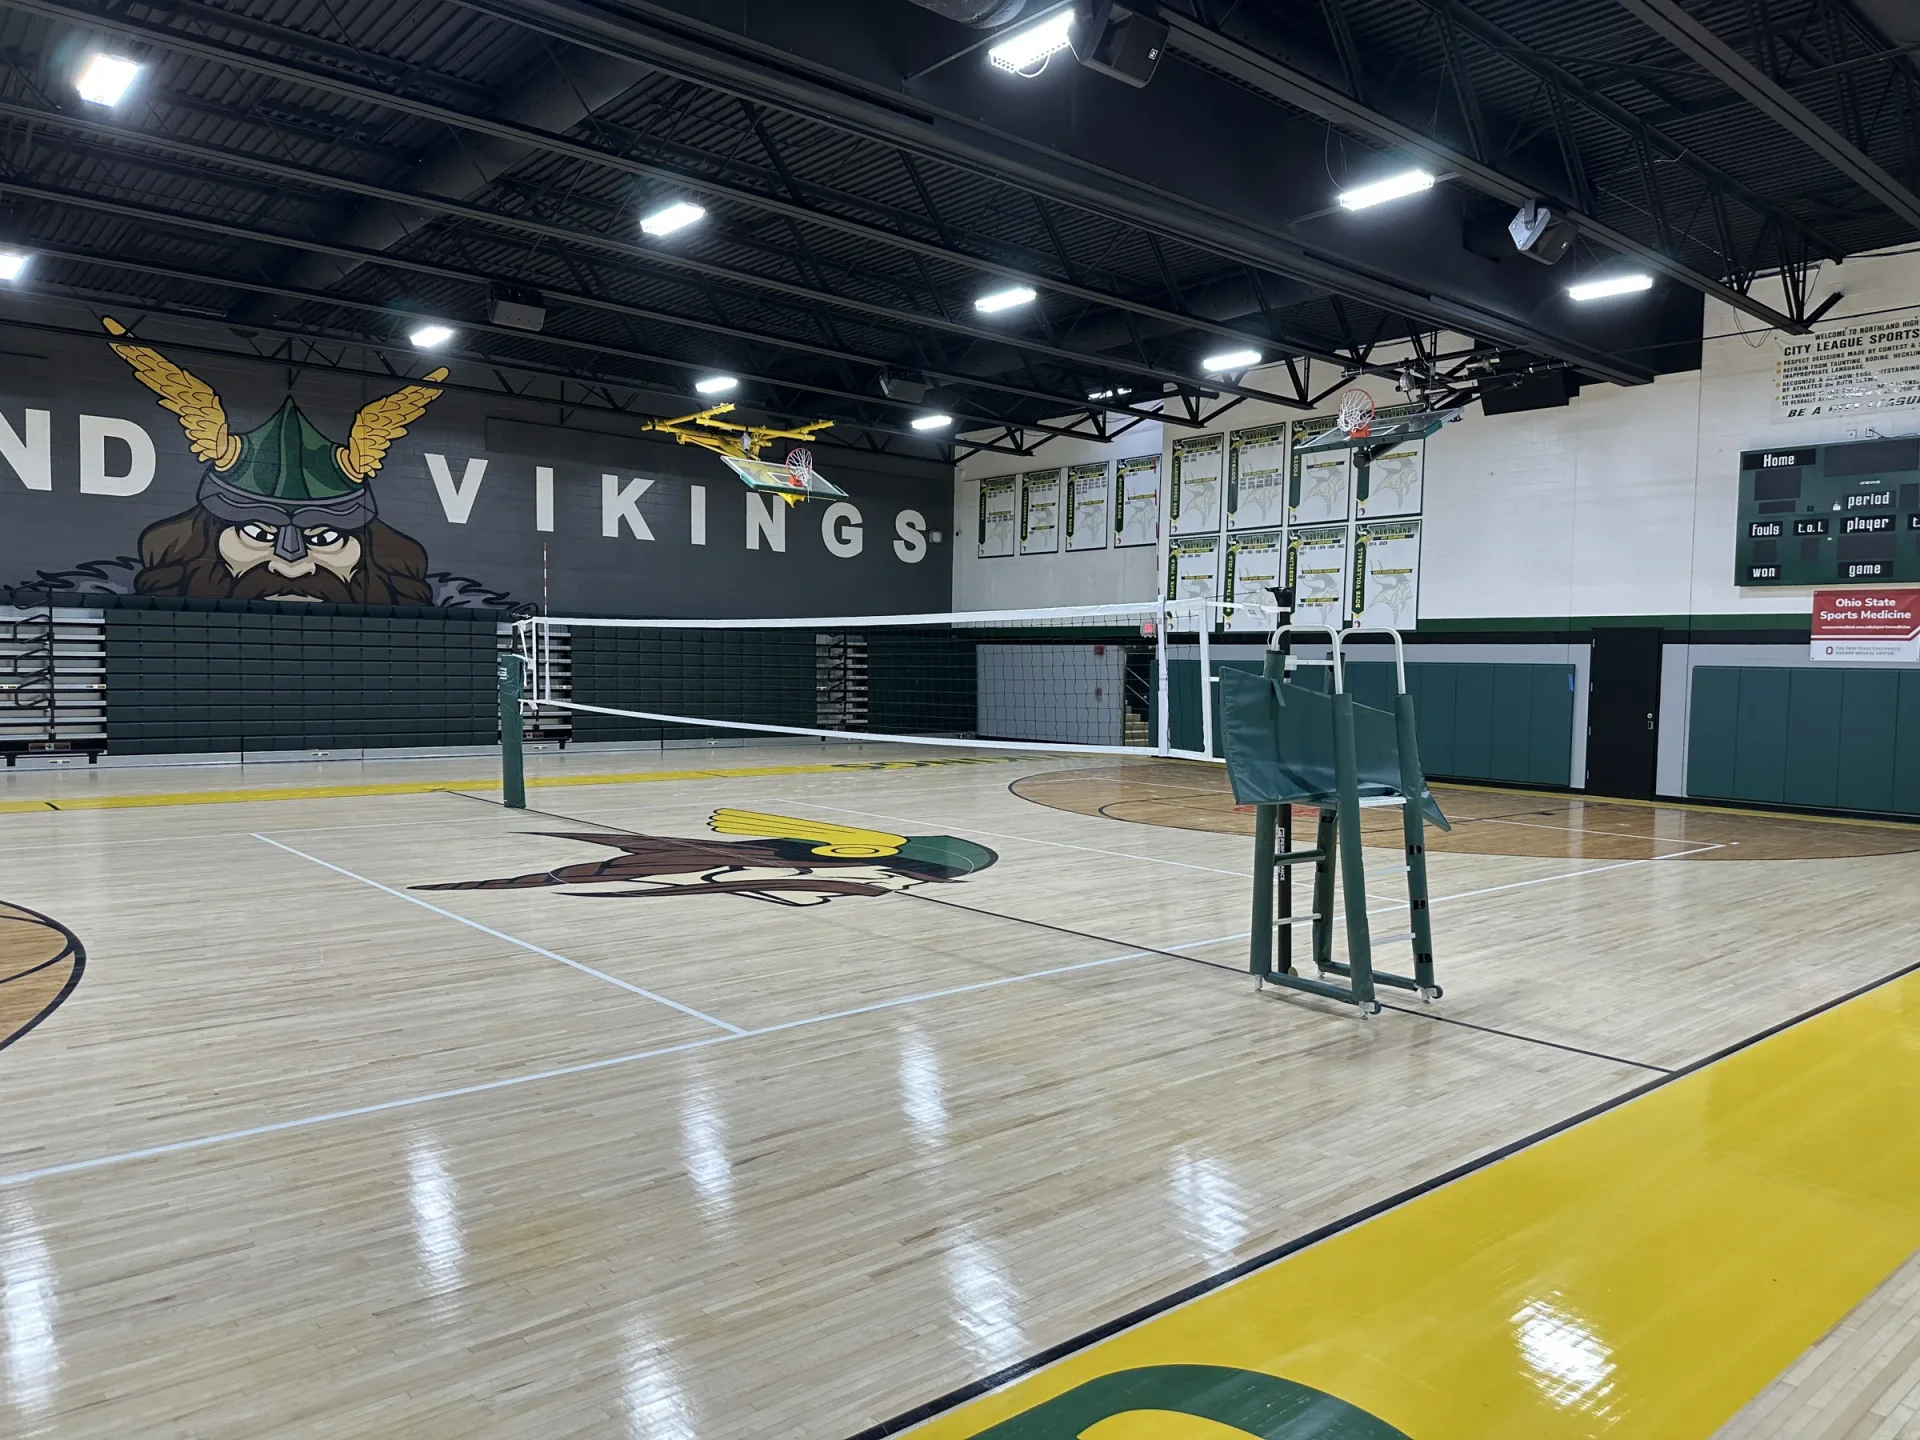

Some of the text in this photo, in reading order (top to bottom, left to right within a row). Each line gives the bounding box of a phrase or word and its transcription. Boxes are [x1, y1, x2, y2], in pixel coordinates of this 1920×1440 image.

[1815, 330, 1846, 340] WELCOME
[1860, 322, 1900, 334] NORTHLAND
[1902, 319, 1919, 327] HIGH
[1784, 344, 1811, 356] CITY
[1816, 337, 1863, 352] LEAGUE
[1783, 357, 1809, 366] RESPECT
[1812, 352, 1845, 362] DECISIONS
[1847, 349, 1865, 357] MADE
[1878, 343, 1908, 353] CONTEST
[1782, 368, 1829, 379] INAPPROPRIATE
[1783, 366, 1809, 374] REFRAIN
[1810, 363, 1828, 371] FROM
[1782, 377, 1816, 387] RECOGNIZE
[1792, 383, 1823, 391] ATHLETES
[1787, 408, 1807, 418] BE
[1811, 406, 1821, 416] A
[1763, 454, 1795, 467] Home
[1847, 491, 1890, 509] period
[424, 453, 928, 564] VIKINGS
[1375, 526, 1412, 536] NORTHLAND
[1752, 523, 1780, 536] fouls
[1846, 517, 1889, 533] player
[1752, 567, 1776, 578] won
[1848, 564, 1881, 578] game
[1835, 597, 1896, 607] Ohio State
[1820, 609, 1912, 621] Sports Medicine
